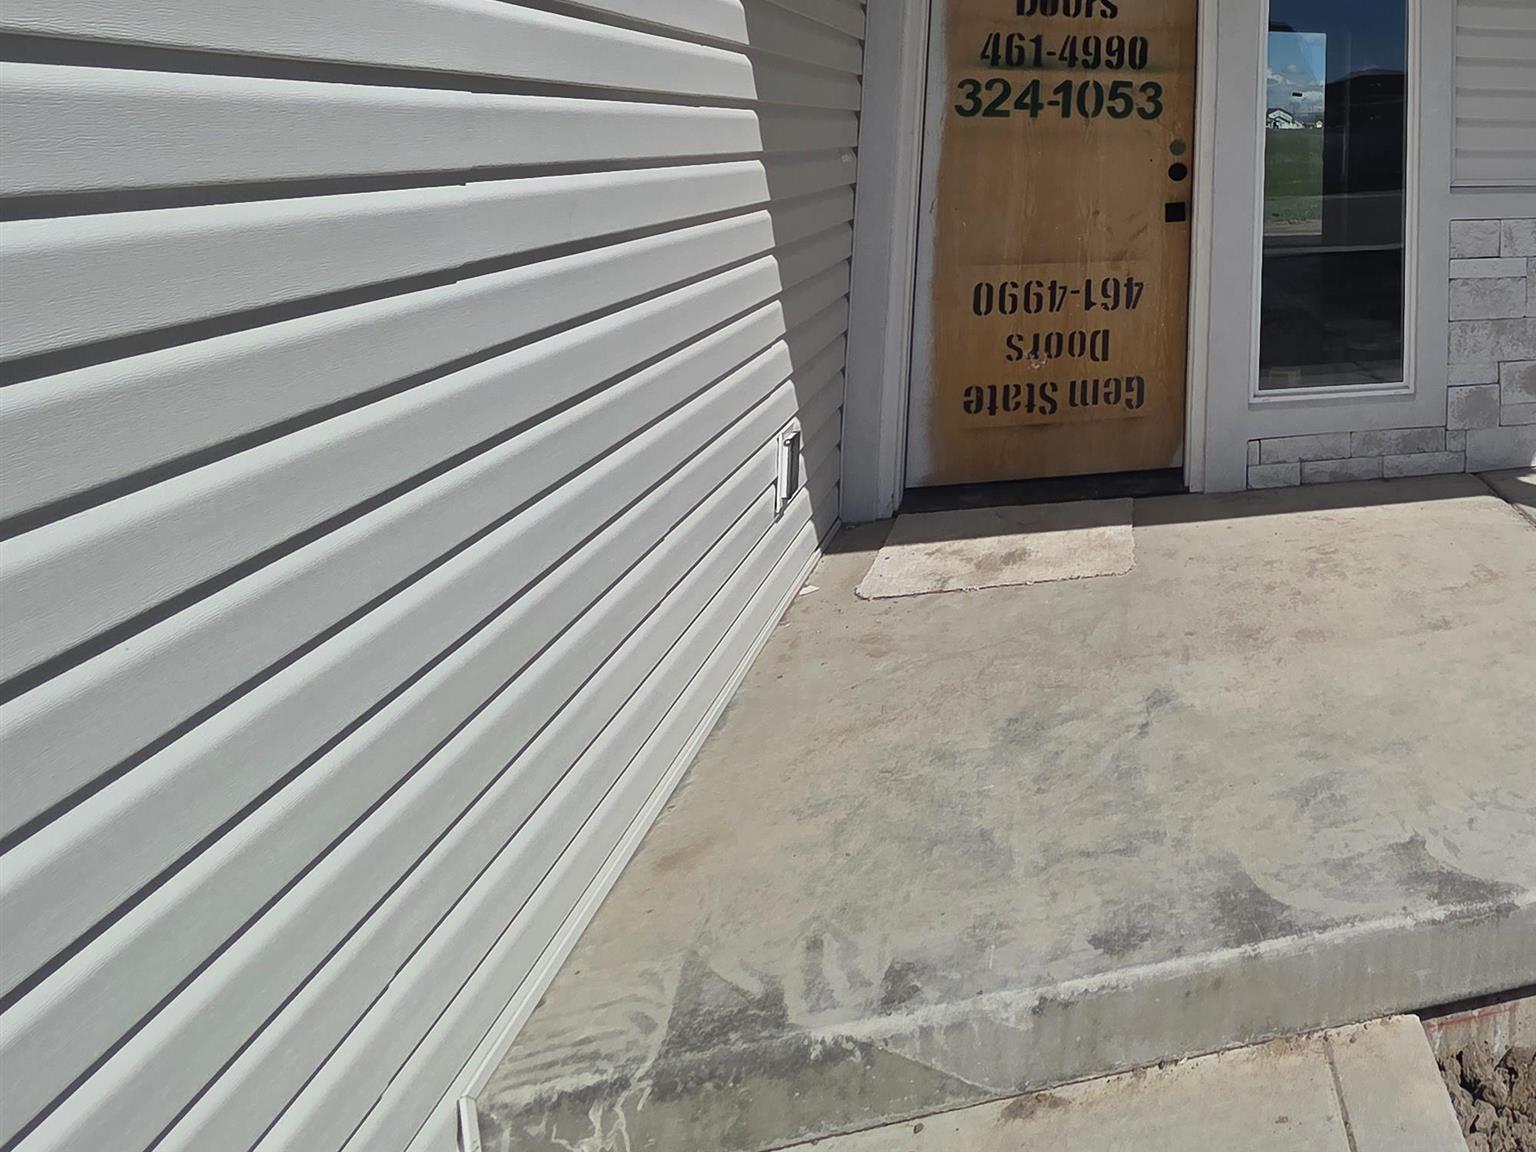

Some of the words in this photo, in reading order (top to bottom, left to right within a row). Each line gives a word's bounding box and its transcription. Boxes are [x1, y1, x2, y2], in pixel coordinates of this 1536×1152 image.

[980, 32, 1149, 70] 461-4990
[954, 78, 1164, 120] 324-1053
[972, 277, 1144, 316] 461-4990
[1006, 329, 1110, 362] Doors
[963, 381, 1058, 415] State
[1068, 376, 1145, 409] Gem
